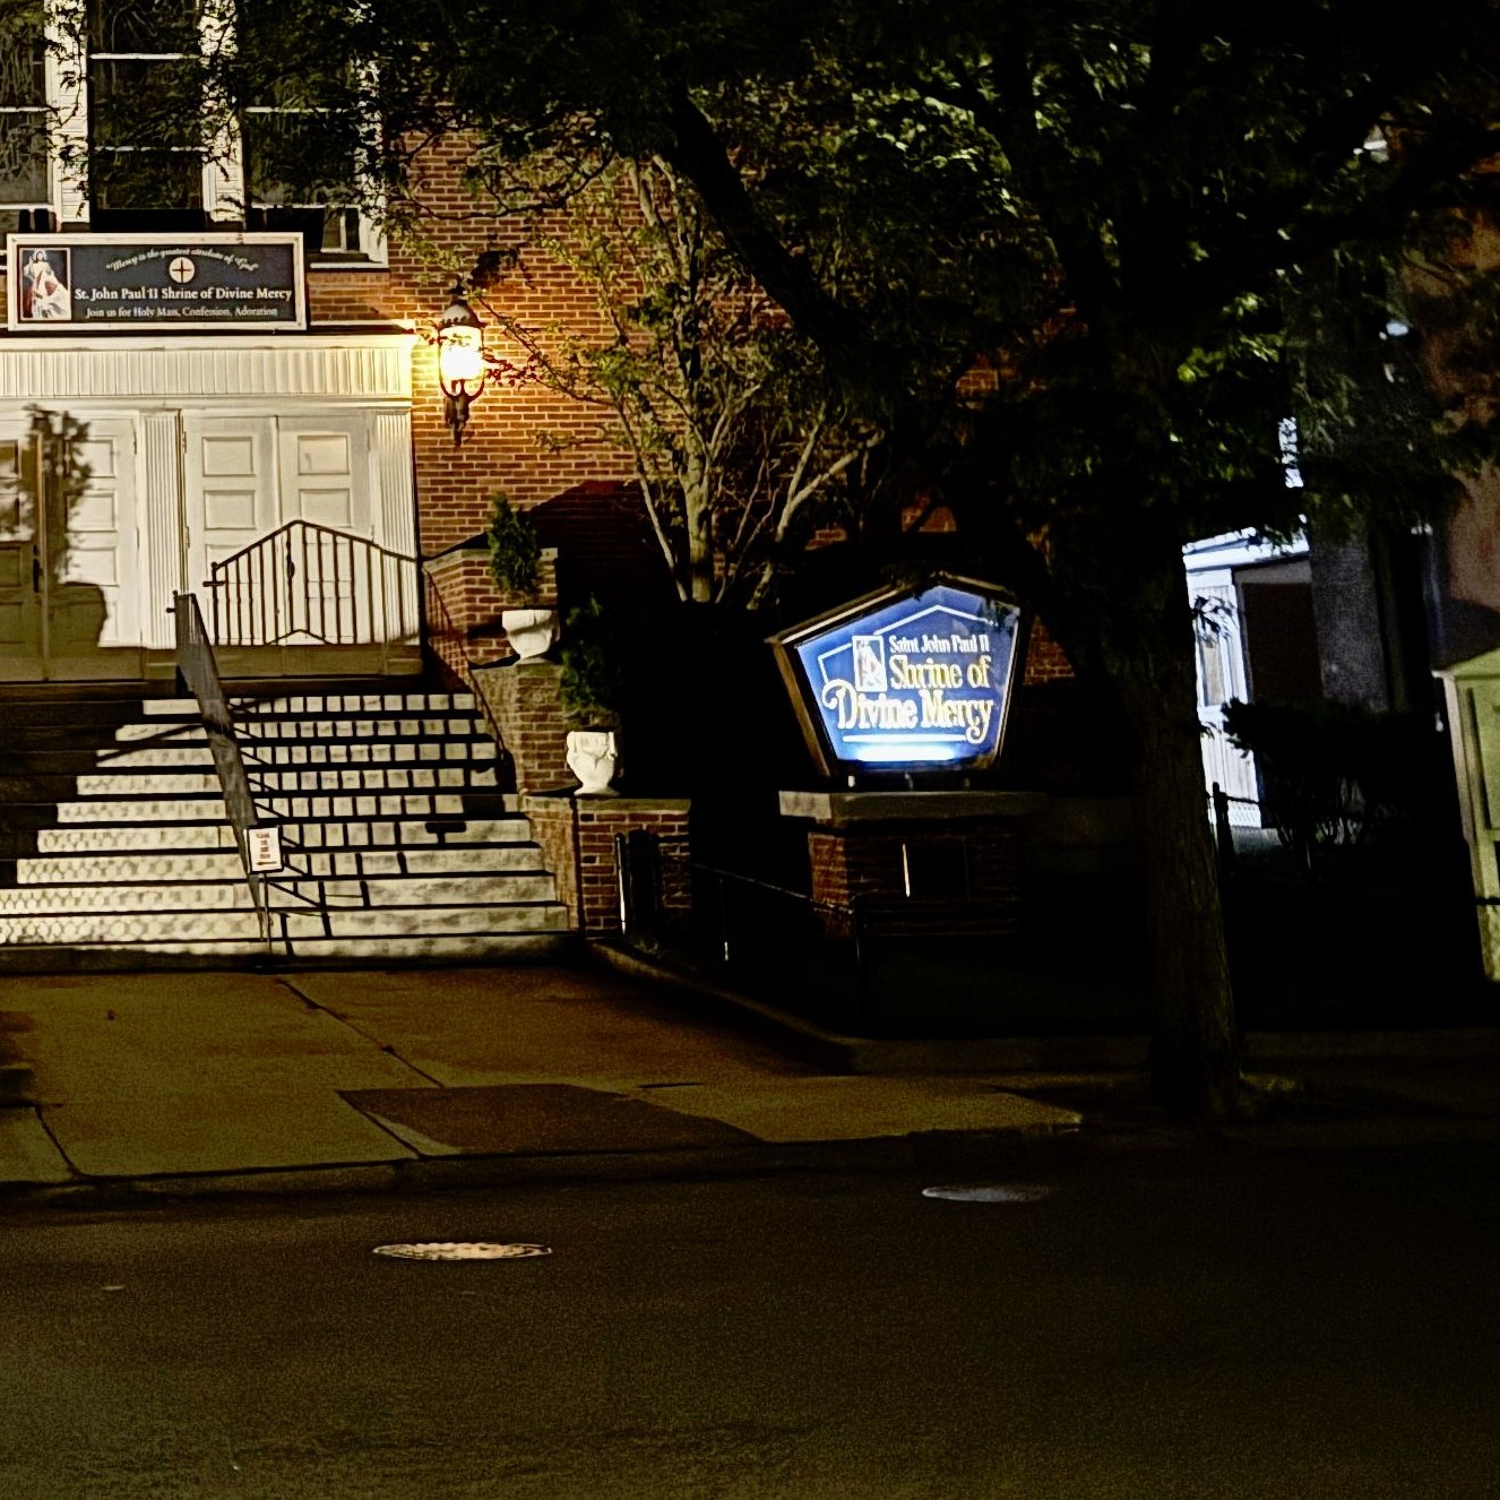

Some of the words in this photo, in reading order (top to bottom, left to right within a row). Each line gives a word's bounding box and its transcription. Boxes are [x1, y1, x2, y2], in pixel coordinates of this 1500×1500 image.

[147, 249, 159, 258] the
[224, 254, 235, 265] of
[74, 288, 89, 300] St.
[90, 286, 118, 301] John
[121, 286, 146, 299] Paul
[148, 288, 158, 299] II
[161, 286, 198, 299] Shrine
[200, 286, 214, 299] of
[215, 287, 254, 299] Divine
[256, 287, 292, 301] Mercy
[85, 308, 104, 318] Join
[118, 306, 131, 317] for
[133, 306, 155, 317] Holy
[234, 305, 278, 316] Adoration
[888, 635, 920, 654] Saint
[920, 635, 951, 654] John
[952, 634, 977, 653] Paul
[979, 634, 990, 652] II
[889, 655, 963, 690] Shrine
[967, 655, 991, 688] of
[821, 678, 918, 730] Divine
[920, 690, 994, 744] Mercy
